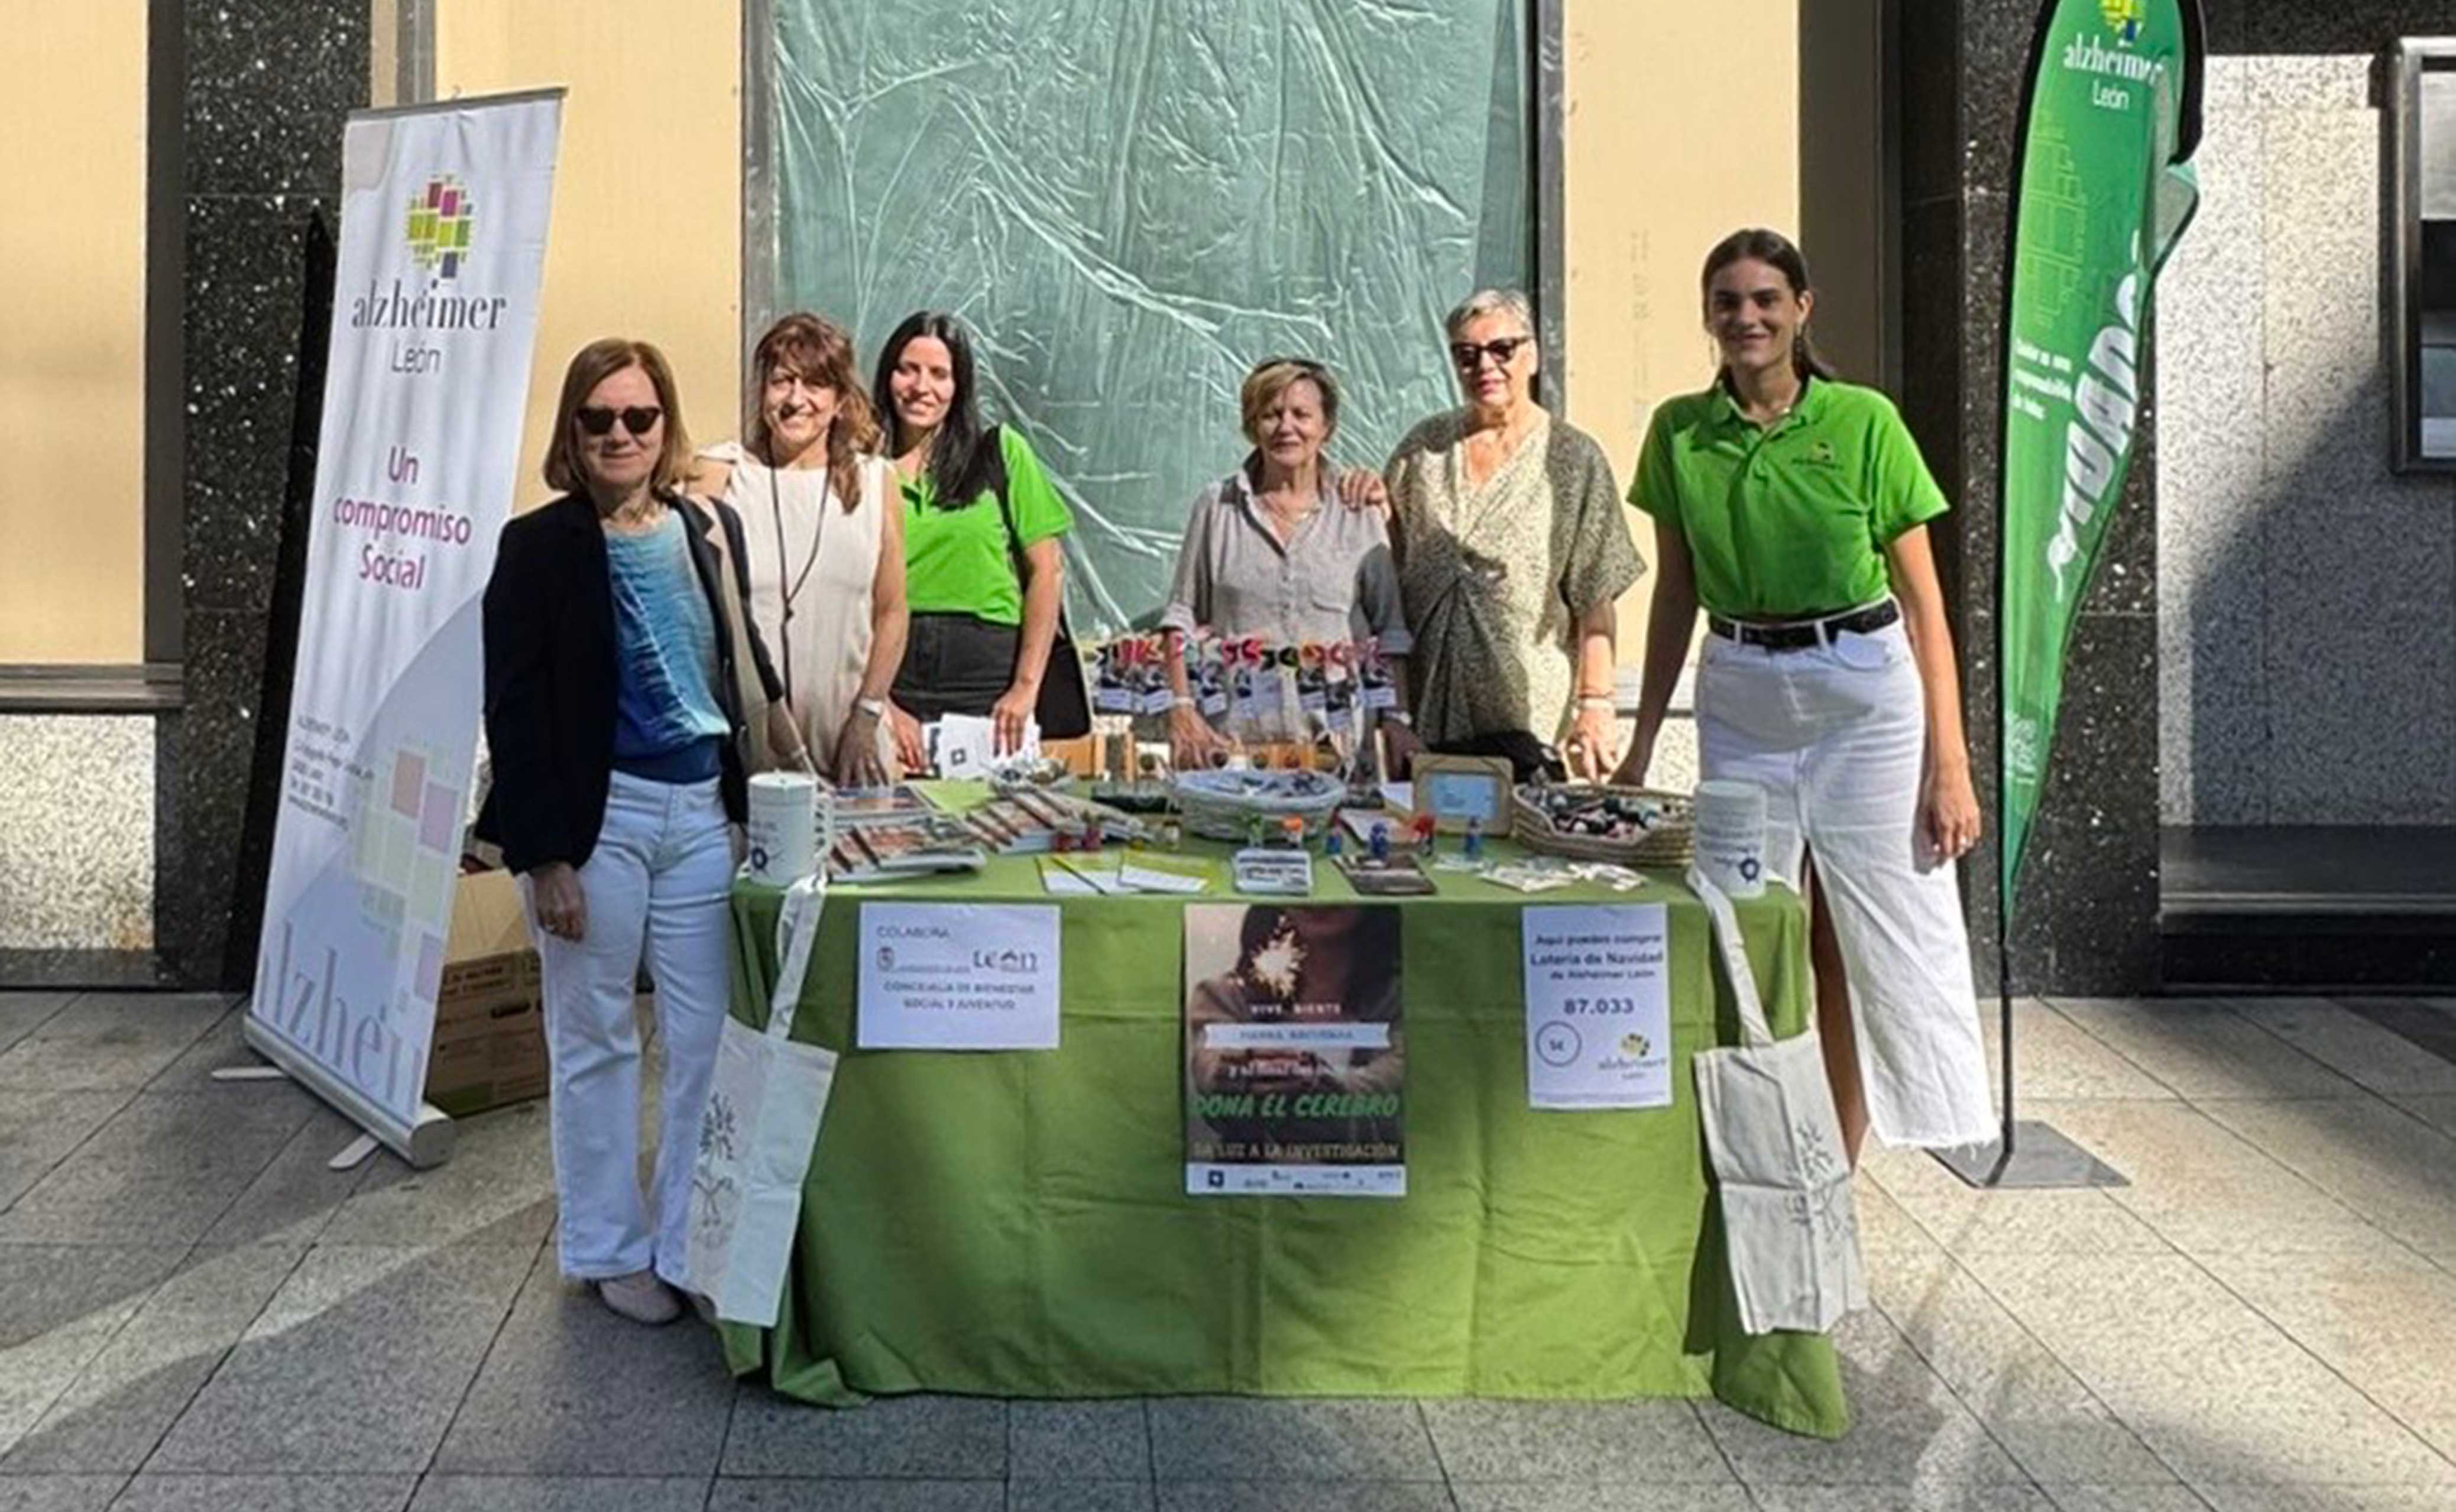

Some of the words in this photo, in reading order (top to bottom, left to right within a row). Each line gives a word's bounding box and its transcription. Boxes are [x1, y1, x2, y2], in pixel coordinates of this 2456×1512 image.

[2063, 32, 2163, 86] alzheimer
[2093, 72, 2130, 110] León
[351, 278, 507, 330] alzheimer
[391, 339, 442, 374] León
[388, 446, 419, 485] Un
[333, 497, 472, 546] compromiso
[359, 543, 426, 590] Social
[1584, 952, 1602, 965] de
[1606, 950, 1664, 964] Navidad
[1564, 997, 1634, 1015] 87.033
[1259, 1094, 1288, 1118] EL
[1293, 1094, 1399, 1118] CEREBRO
